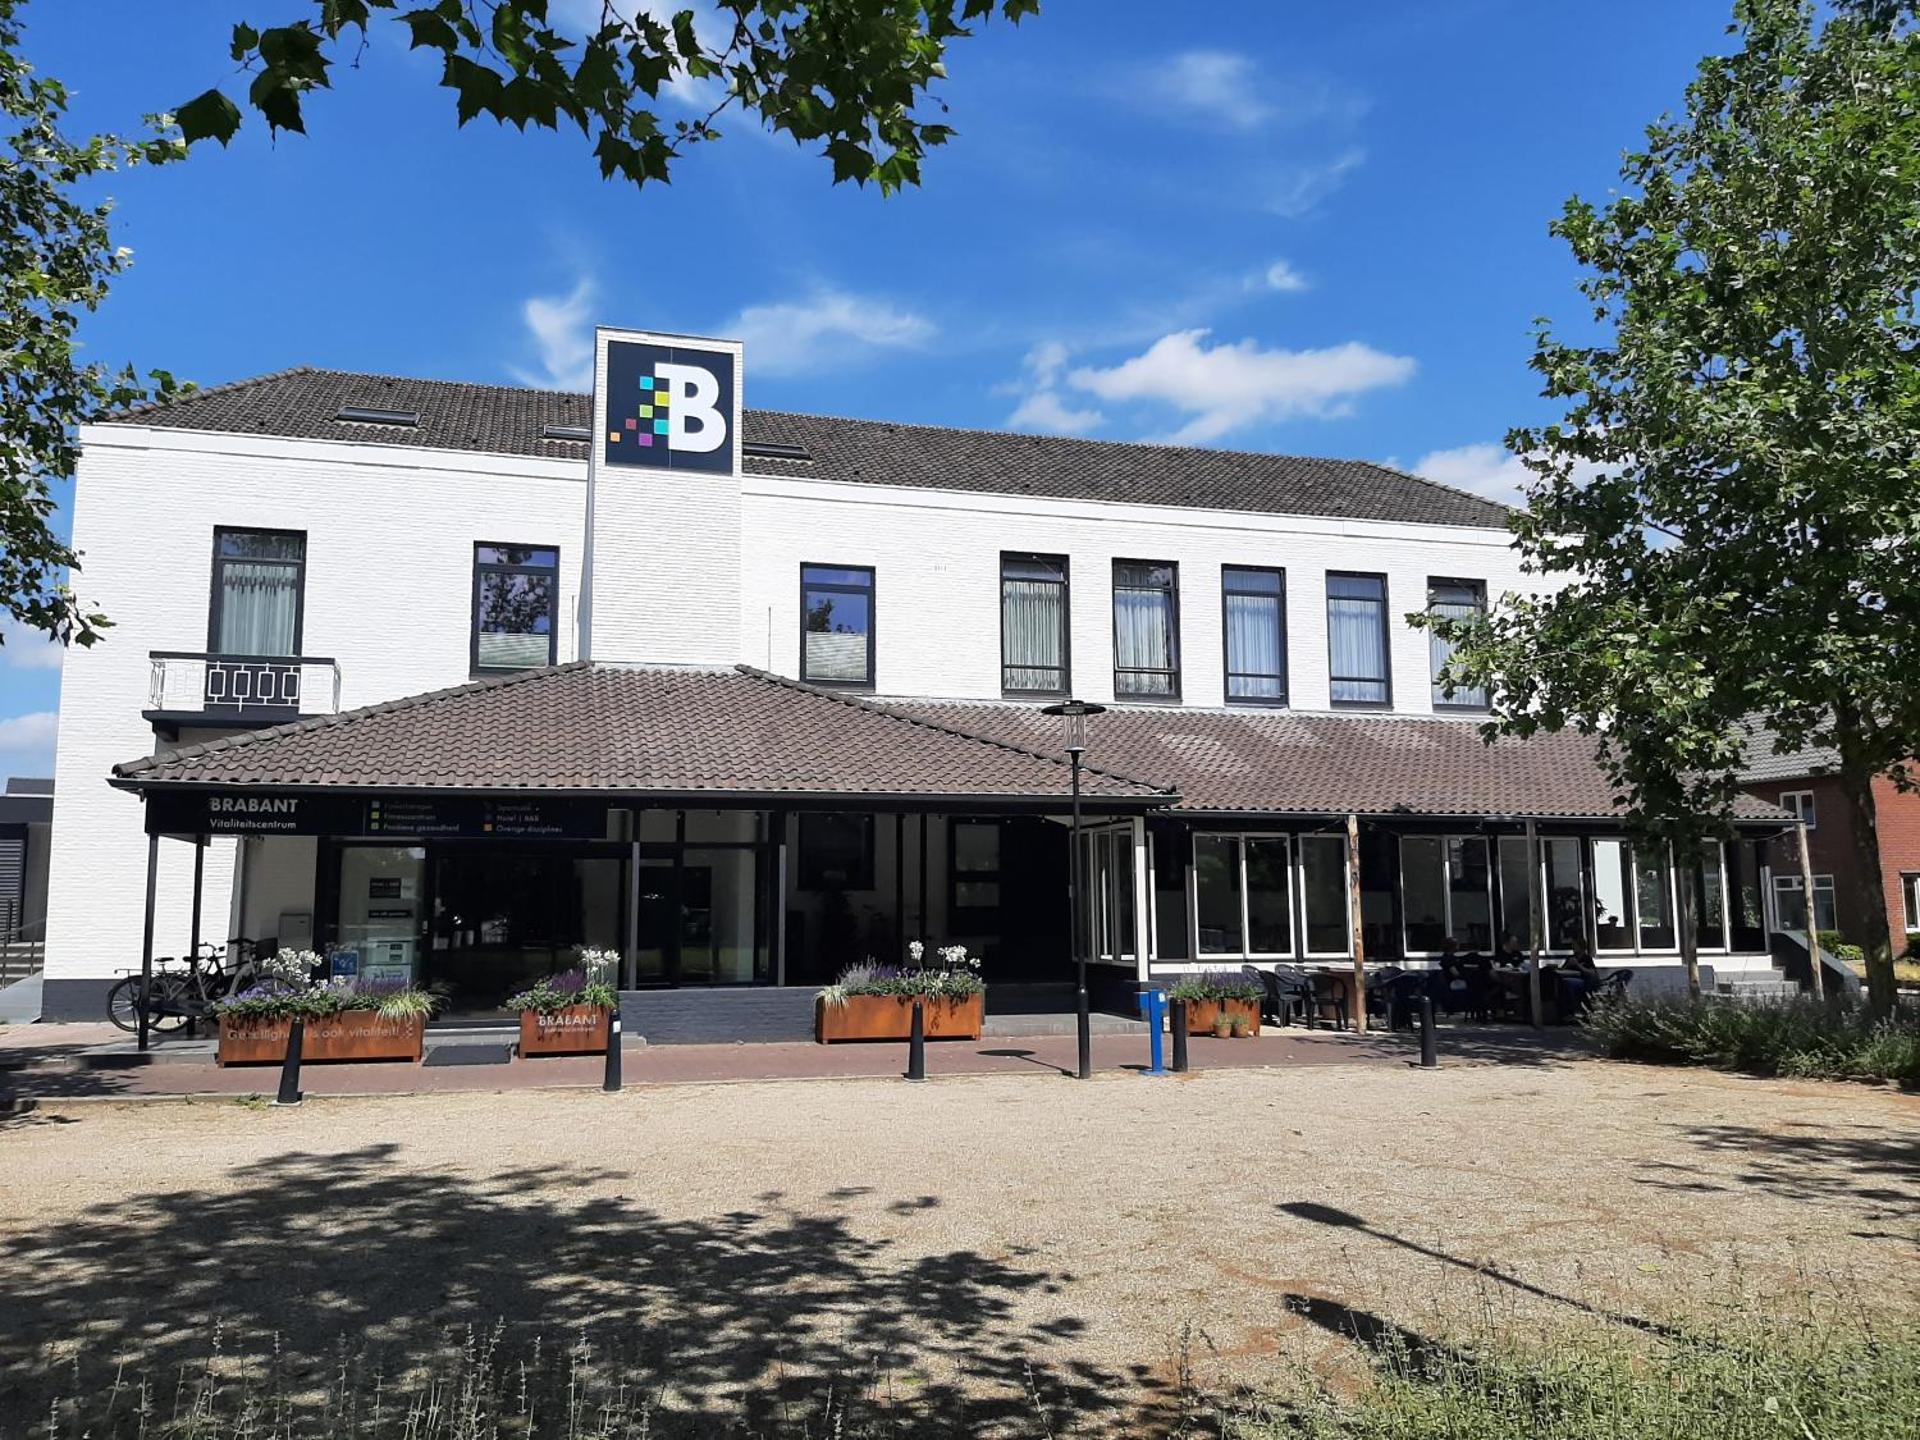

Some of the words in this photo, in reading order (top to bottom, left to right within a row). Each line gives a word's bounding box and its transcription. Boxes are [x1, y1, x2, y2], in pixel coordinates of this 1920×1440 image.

[654, 362, 727, 453] B
[209, 797, 299, 813] BRABANT
[209, 818, 297, 829] Vitaliteitscentrum
[496, 824, 525, 833] Overige
[527, 824, 563, 833] disciplines
[538, 1015, 598, 1026] BRABANT
[322, 1026, 344, 1037] ook
